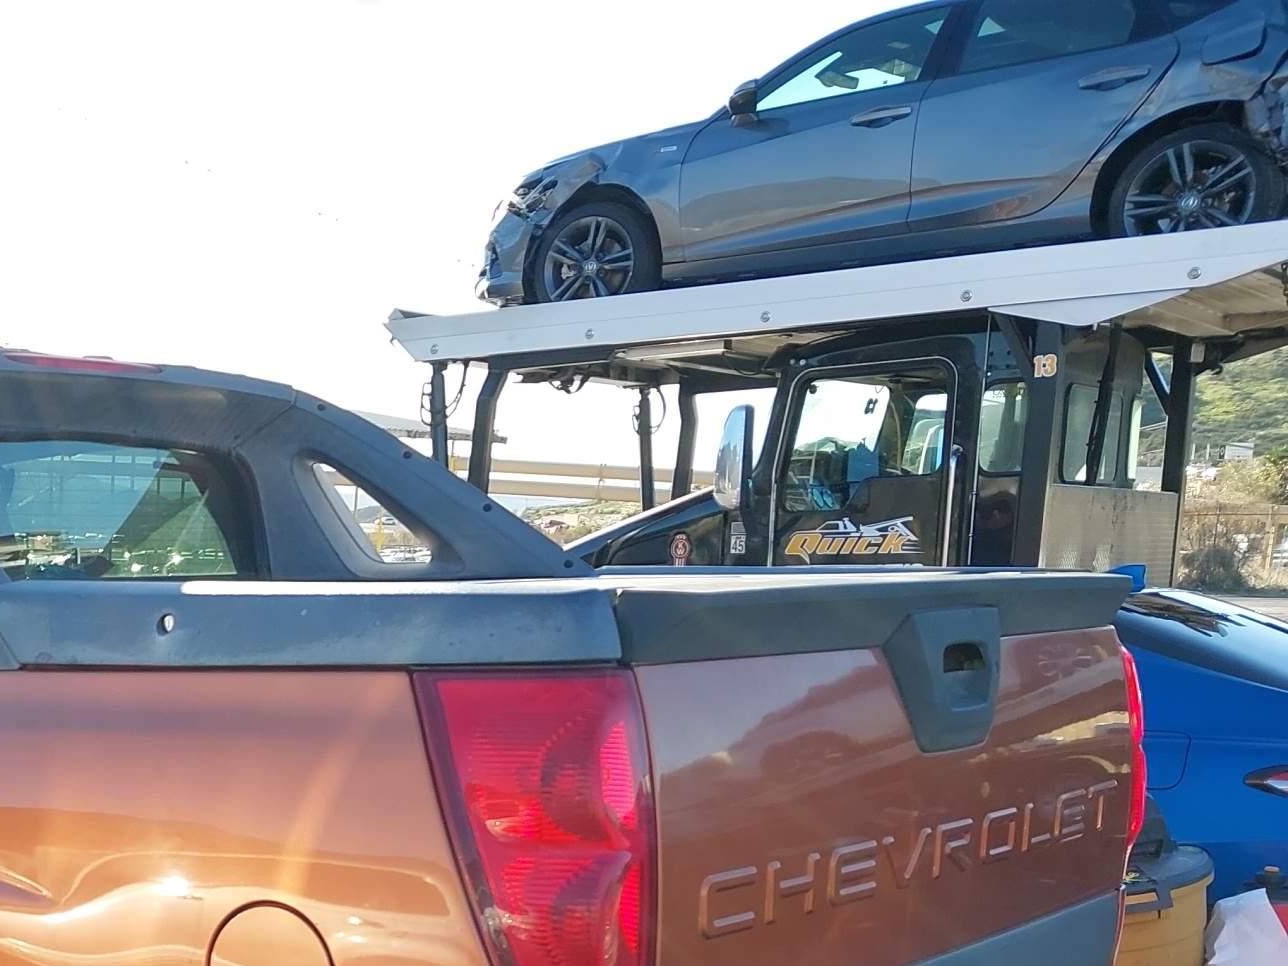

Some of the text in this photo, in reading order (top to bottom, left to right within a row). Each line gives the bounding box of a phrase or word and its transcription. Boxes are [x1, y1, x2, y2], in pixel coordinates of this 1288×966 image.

[1033, 353, 1058, 378] 13
[732, 540, 745, 553] 45
[698, 780, 1119, 939] CHEVROLET
